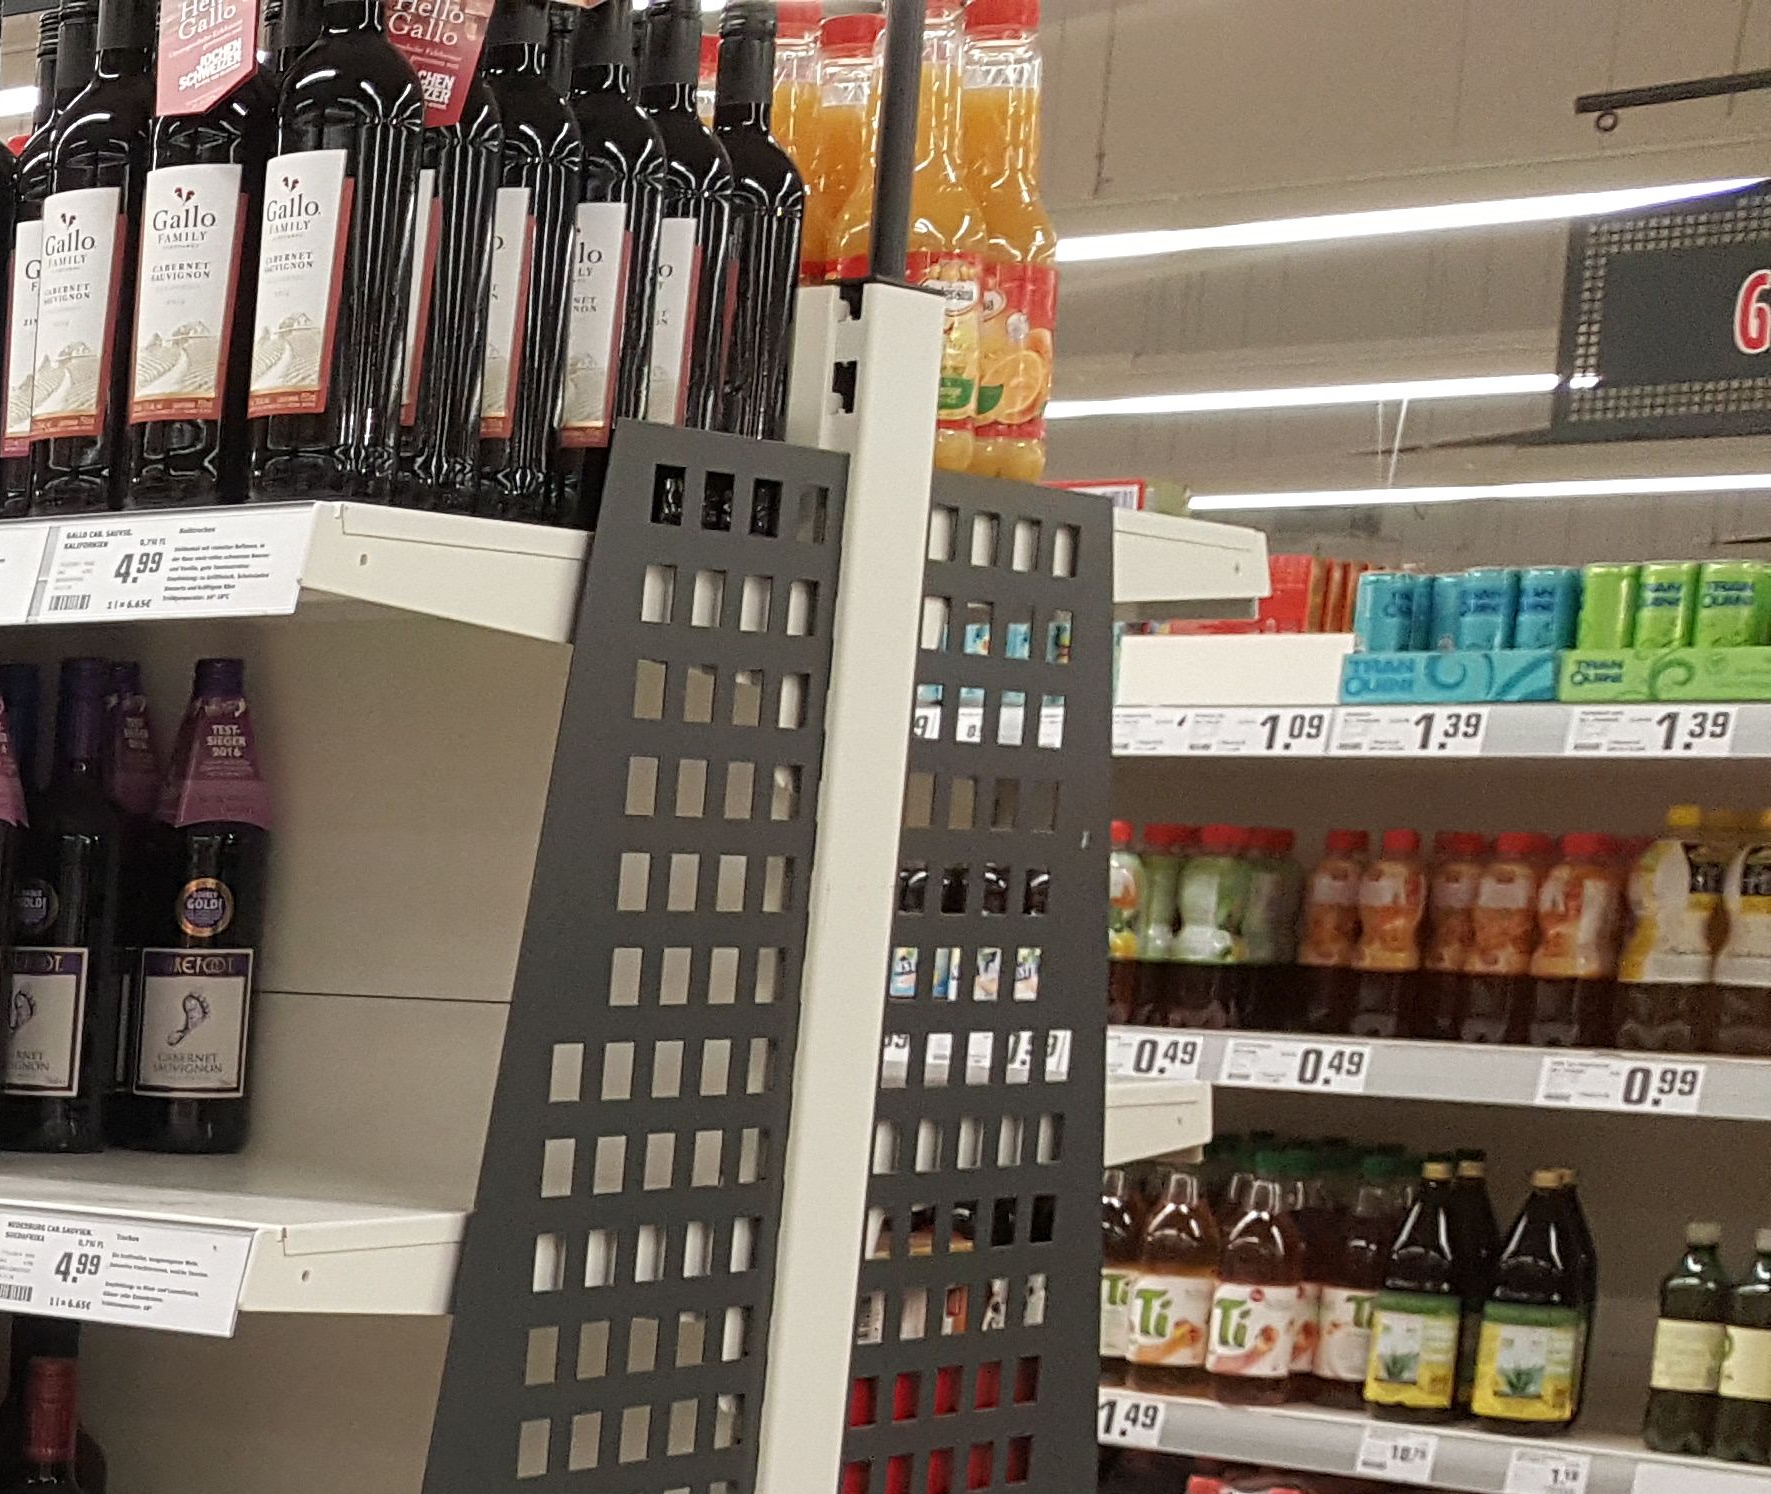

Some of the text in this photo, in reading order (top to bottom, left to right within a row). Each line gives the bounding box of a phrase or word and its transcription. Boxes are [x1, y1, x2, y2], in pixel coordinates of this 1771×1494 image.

[177, 5, 238, 41] Gallo
[389, 16, 459, 46] Gallo
[199, 39, 243, 71] JOCHEN
[178, 53, 243, 92] SCHWEIZER
[418, 70, 456, 90] CHEN
[152, 205, 217, 232] Gallo
[266, 194, 321, 221] Gallo
[45, 229, 96, 257] Gallo
[114, 552, 164, 584] 4.99
[206, 735, 247, 748] SIEGER
[211, 724, 242, 736] TEST-
[1261, 713, 1326, 750] 1.09
[1415, 712, 1482, 750] 1.39
[1656, 711, 1731, 750] 1.39
[211, 746, 243, 759] 2016
[1132, 1040, 1197, 1076] 0.49
[1296, 1048, 1366, 1087] 0.49
[1622, 1068, 1698, 1107] 0.99
[55, 1251, 102, 1284] 4.99
[1099, 1399, 1158, 1436] 1.49
